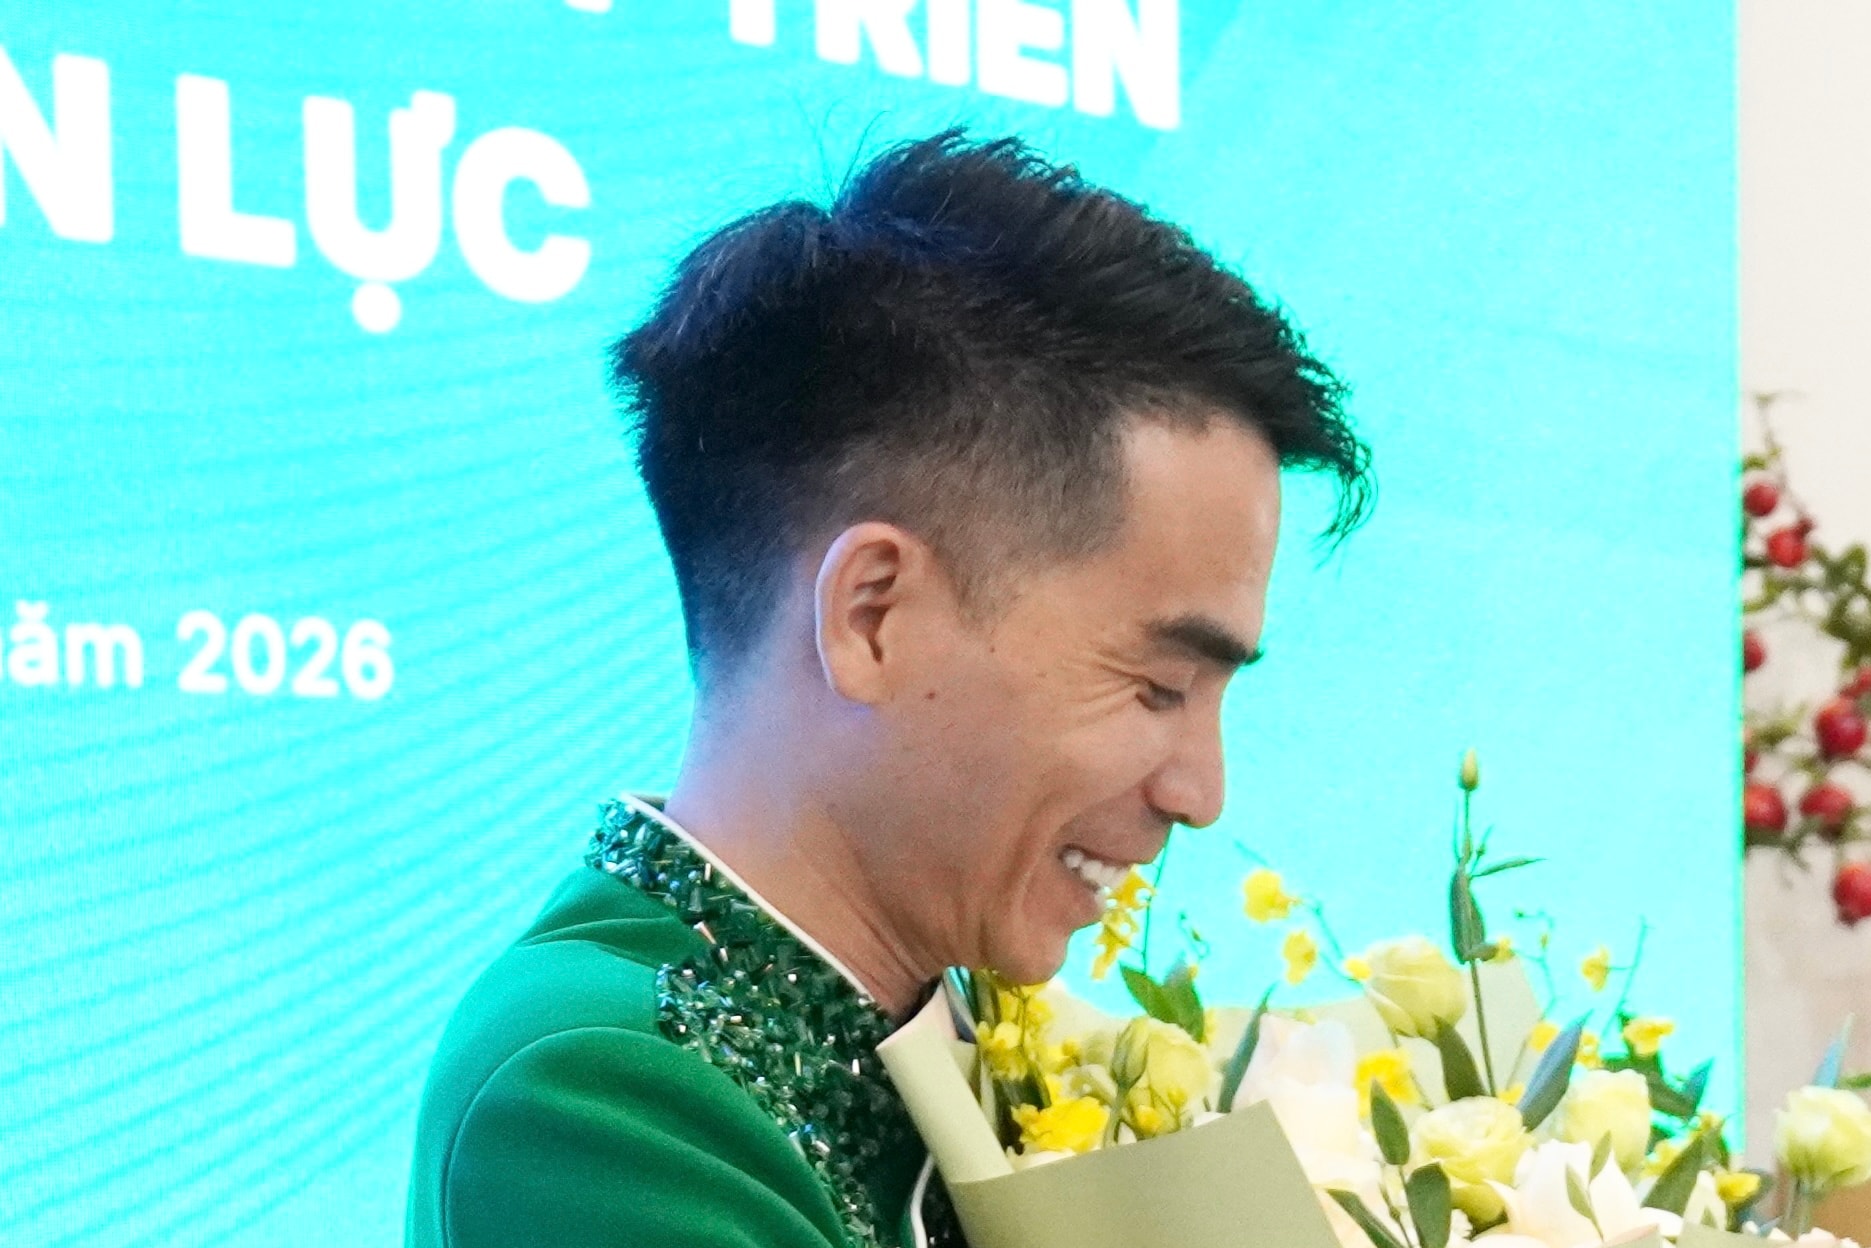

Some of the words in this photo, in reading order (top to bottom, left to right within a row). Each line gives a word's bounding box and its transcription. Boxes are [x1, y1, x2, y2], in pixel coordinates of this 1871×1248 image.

[175, 73, 592, 335] LỰC
[0, 599, 145, 688] ăm
[176, 609, 395, 701] 2026
